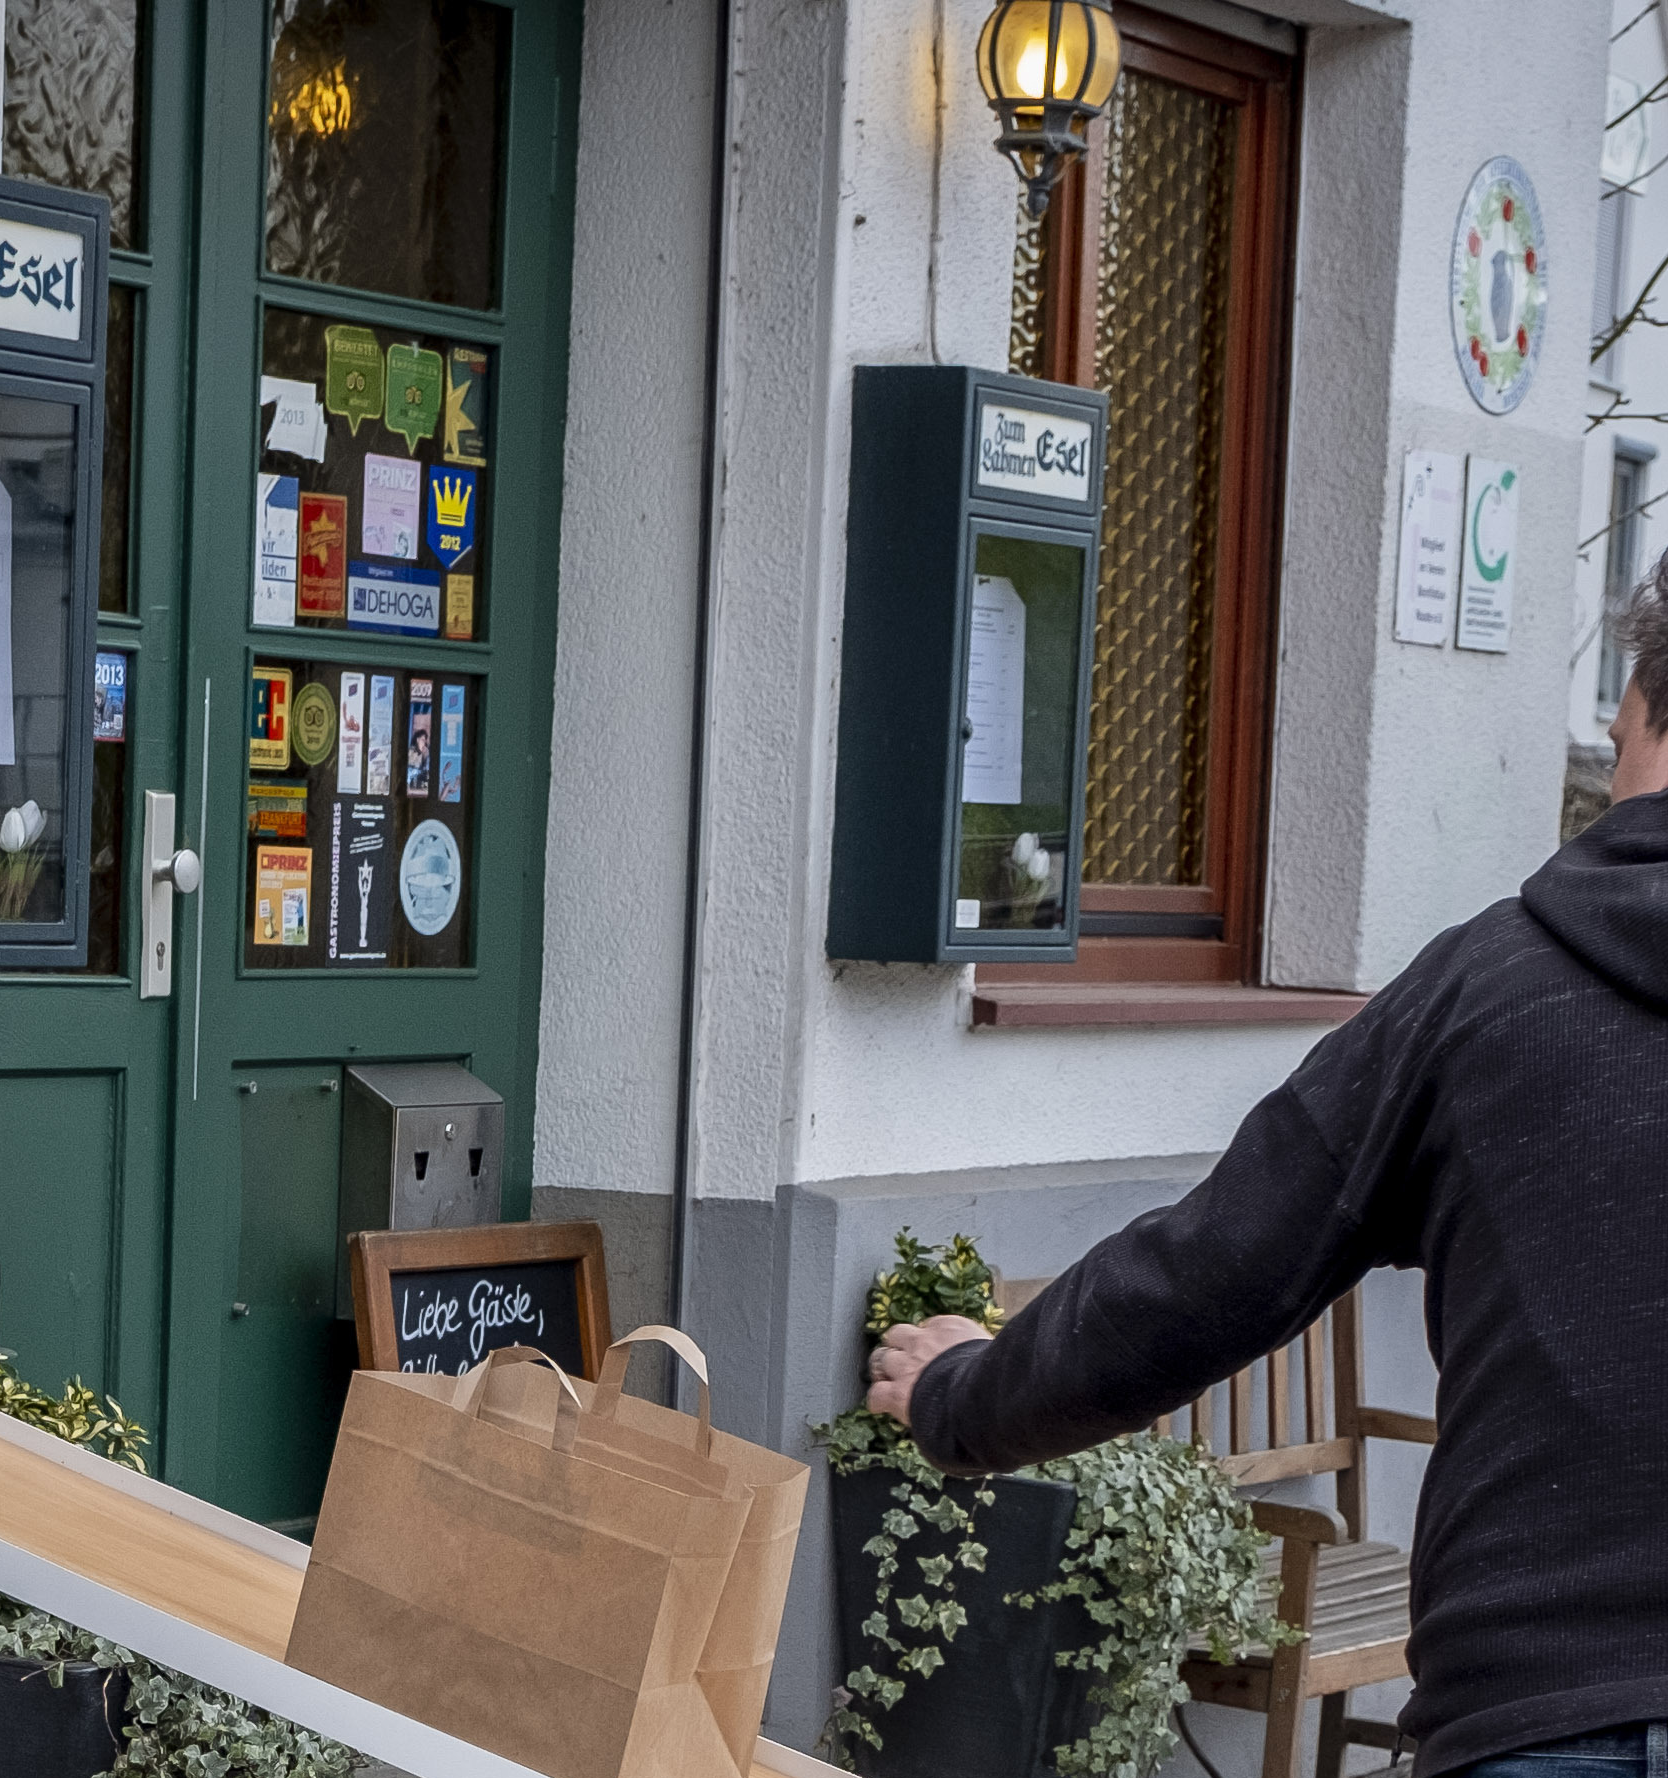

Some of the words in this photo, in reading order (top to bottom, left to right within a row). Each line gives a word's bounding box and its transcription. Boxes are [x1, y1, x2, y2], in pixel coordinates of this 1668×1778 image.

[279, 407, 305, 426] 2013
[994, 412, 1025, 445] Zum
[1036, 428, 1088, 478] Esel
[367, 463, 418, 491] PRINZ
[439, 534, 462, 551] 2012
[261, 558, 287, 577] ilden
[366, 588, 434, 619] DEHOGA
[94, 663, 125, 686] 2013
[412, 682, 433, 697] 2009
[269, 854, 309, 871] PRINZ
[329, 802, 342, 959] GASTRONOMIEPREIS
[401, 1287, 462, 1341] Liebe
[468, 1279, 544, 1360] Gäste,
